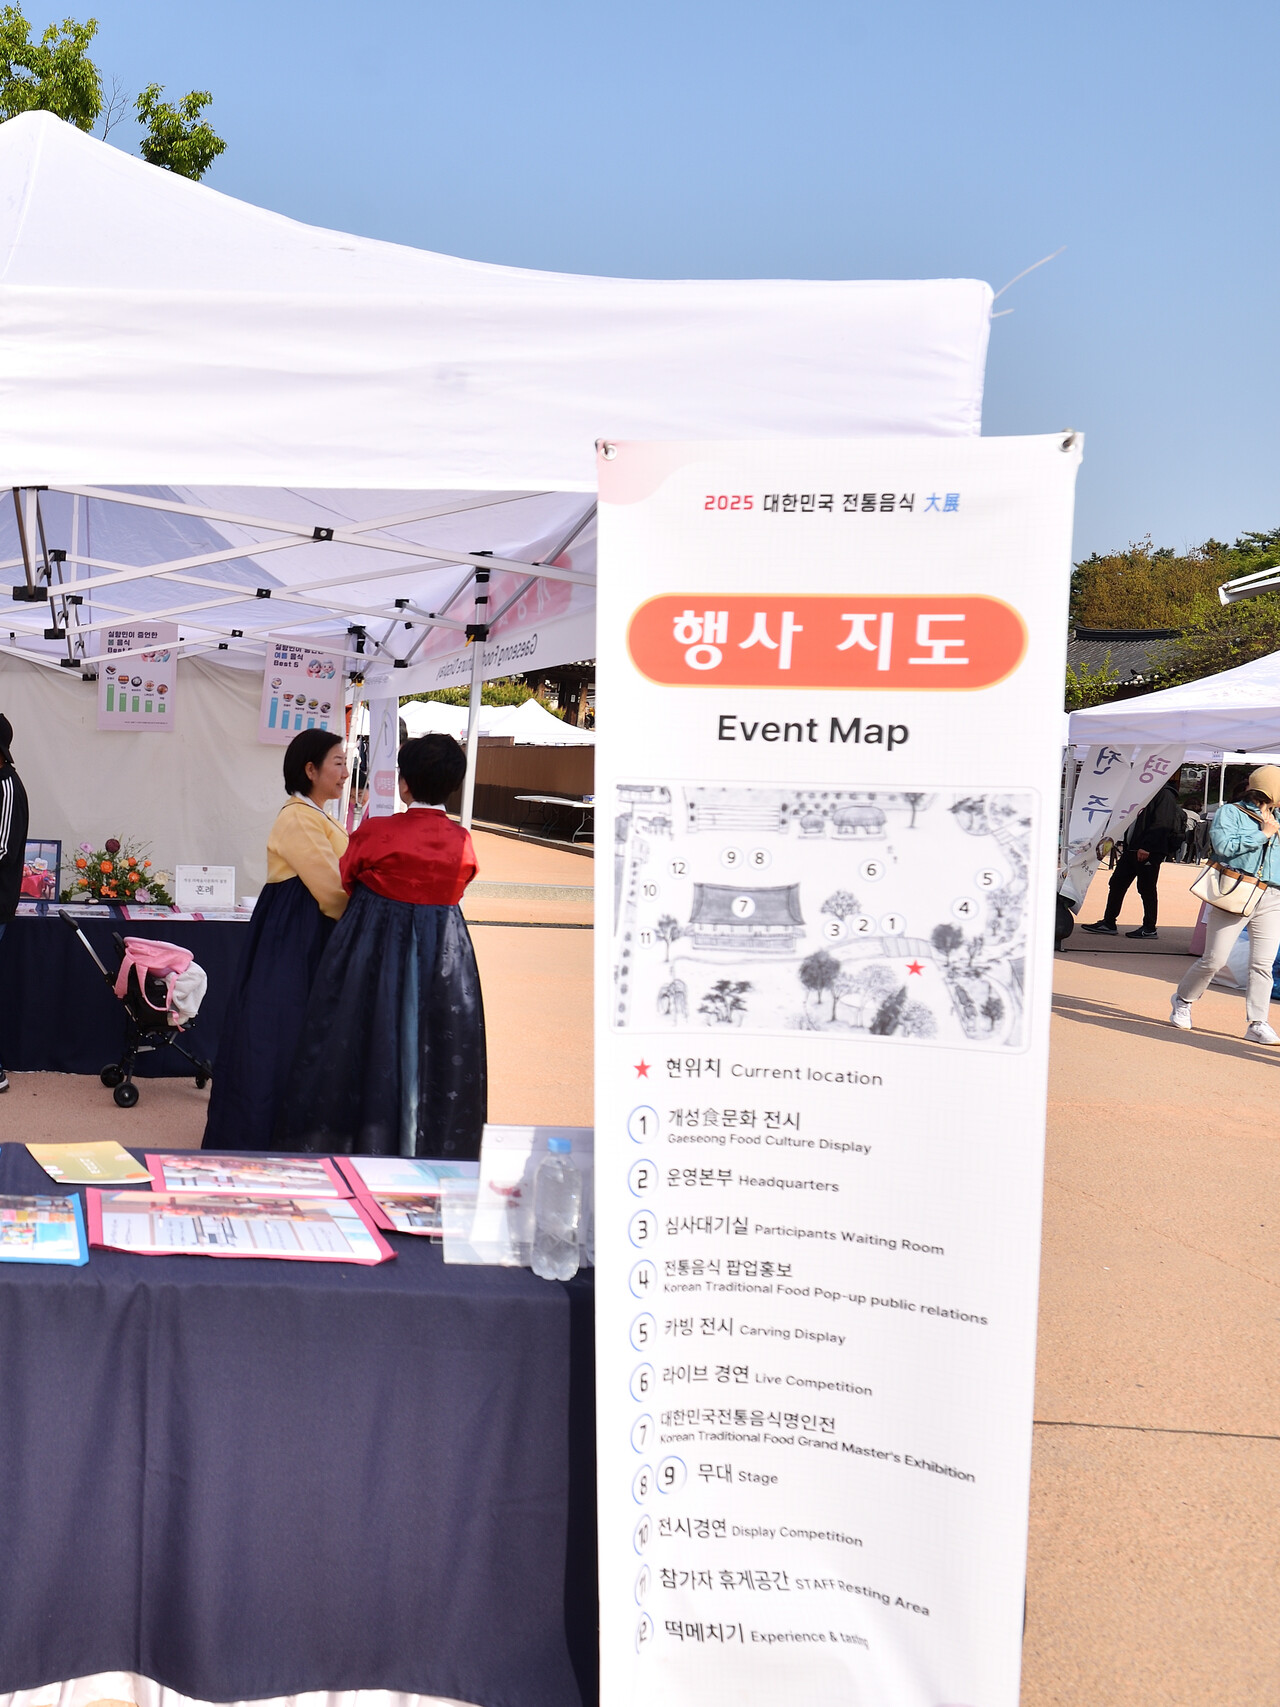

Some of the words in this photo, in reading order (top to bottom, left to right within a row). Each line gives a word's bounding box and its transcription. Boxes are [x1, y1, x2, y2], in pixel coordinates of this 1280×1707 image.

[705, 495, 753, 510] 2025
[763, 493, 834, 513] 대한민국
[843, 493, 915, 512] 전통음식
[924, 493, 960, 513] 大展
[673, 610, 803, 670] 행사
[837, 612, 969, 671] 지도
[718, 715, 818, 743] Event
[830, 717, 909, 751] Map
[672, 862, 685, 874] 12
[727, 852, 735, 863] 9
[755, 852, 764, 864] 8
[867, 864, 876, 876] 6
[983, 873, 992, 885] 5
[195, 885, 214, 896] 혼례
[644, 884, 656, 896] 10
[740, 900, 748, 912] 7
[959, 902, 969, 913] 4
[831, 924, 839, 936] 3
[859, 919, 868, 931] 2
[889, 918, 894, 929] 1
[641, 933, 650, 943] 11
[667, 1058, 720, 1078] 현위치
[731, 1064, 801, 1080] Current
[808, 1068, 882, 1085] location
[640, 1116, 646, 1134] 1
[669, 1108, 757, 1128] 개성食문화
[764, 1111, 800, 1130] 전시
[668, 1134, 726, 1146] Gaeseong
[730, 1134, 761, 1144] Food
[765, 1135, 815, 1148] Culture
[820, 1139, 871, 1155] Display
[638, 1170, 647, 1189] 2
[667, 1168, 732, 1186] 운영본부
[739, 1176, 839, 1192] Headquarters
[639, 1220, 647, 1239] 3
[666, 1216, 748, 1235] 심사대기실
[755, 1224, 836, 1240] Participants
[841, 1232, 897, 1250] Waiting
[902, 1239, 944, 1255] Room
[639, 1271, 648, 1288] 4
[665, 1259, 720, 1276] 전통음식
[727, 1260, 792, 1277] 팝업홍보
[664, 1284, 701, 1292] Korean
[706, 1281, 773, 1293] Traditional
[777, 1284, 810, 1296] Food
[815, 1288, 866, 1305] Pop-up
[871, 1297, 916, 1311] public
[921, 1305, 988, 1325] relations
[640, 1323, 647, 1342] 5
[666, 1318, 693, 1336] 카빙
[700, 1317, 732, 1336] 전시
[740, 1325, 790, 1340] Carving
[795, 1329, 846, 1346] Display
[641, 1373, 648, 1392] 6
[663, 1365, 708, 1384] 라이브
[716, 1365, 748, 1383] 경연
[756, 1374, 781, 1384] Live
[786, 1376, 872, 1396] Competition
[661, 1409, 835, 1435] 대한민국전통음식명인전
[661, 1434, 695, 1443] Korean
[698, 1431, 760, 1442] Traditional
[764, 1433, 794, 1445] Food
[798, 1436, 838, 1450] Grand
[842, 1442, 901, 1463] Master's
[905, 1455, 975, 1482] Exhibition
[665, 1467, 674, 1485] 9
[698, 1464, 732, 1483] 무대
[739, 1471, 778, 1486] Stage
[659, 1518, 726, 1538] 전시경연
[732, 1526, 776, 1539] Display
[780, 1527, 863, 1547] Competition
[660, 1568, 712, 1590] 참가자
[719, 1570, 790, 1591] 휴게공간
[796, 1579, 835, 1590] STAFF
[838, 1580, 890, 1606] Resting
[895, 1597, 929, 1616] Area
[665, 1621, 744, 1643] 떡메치기
[751, 1631, 825, 1645] Experience
[829, 1631, 837, 1642] &
